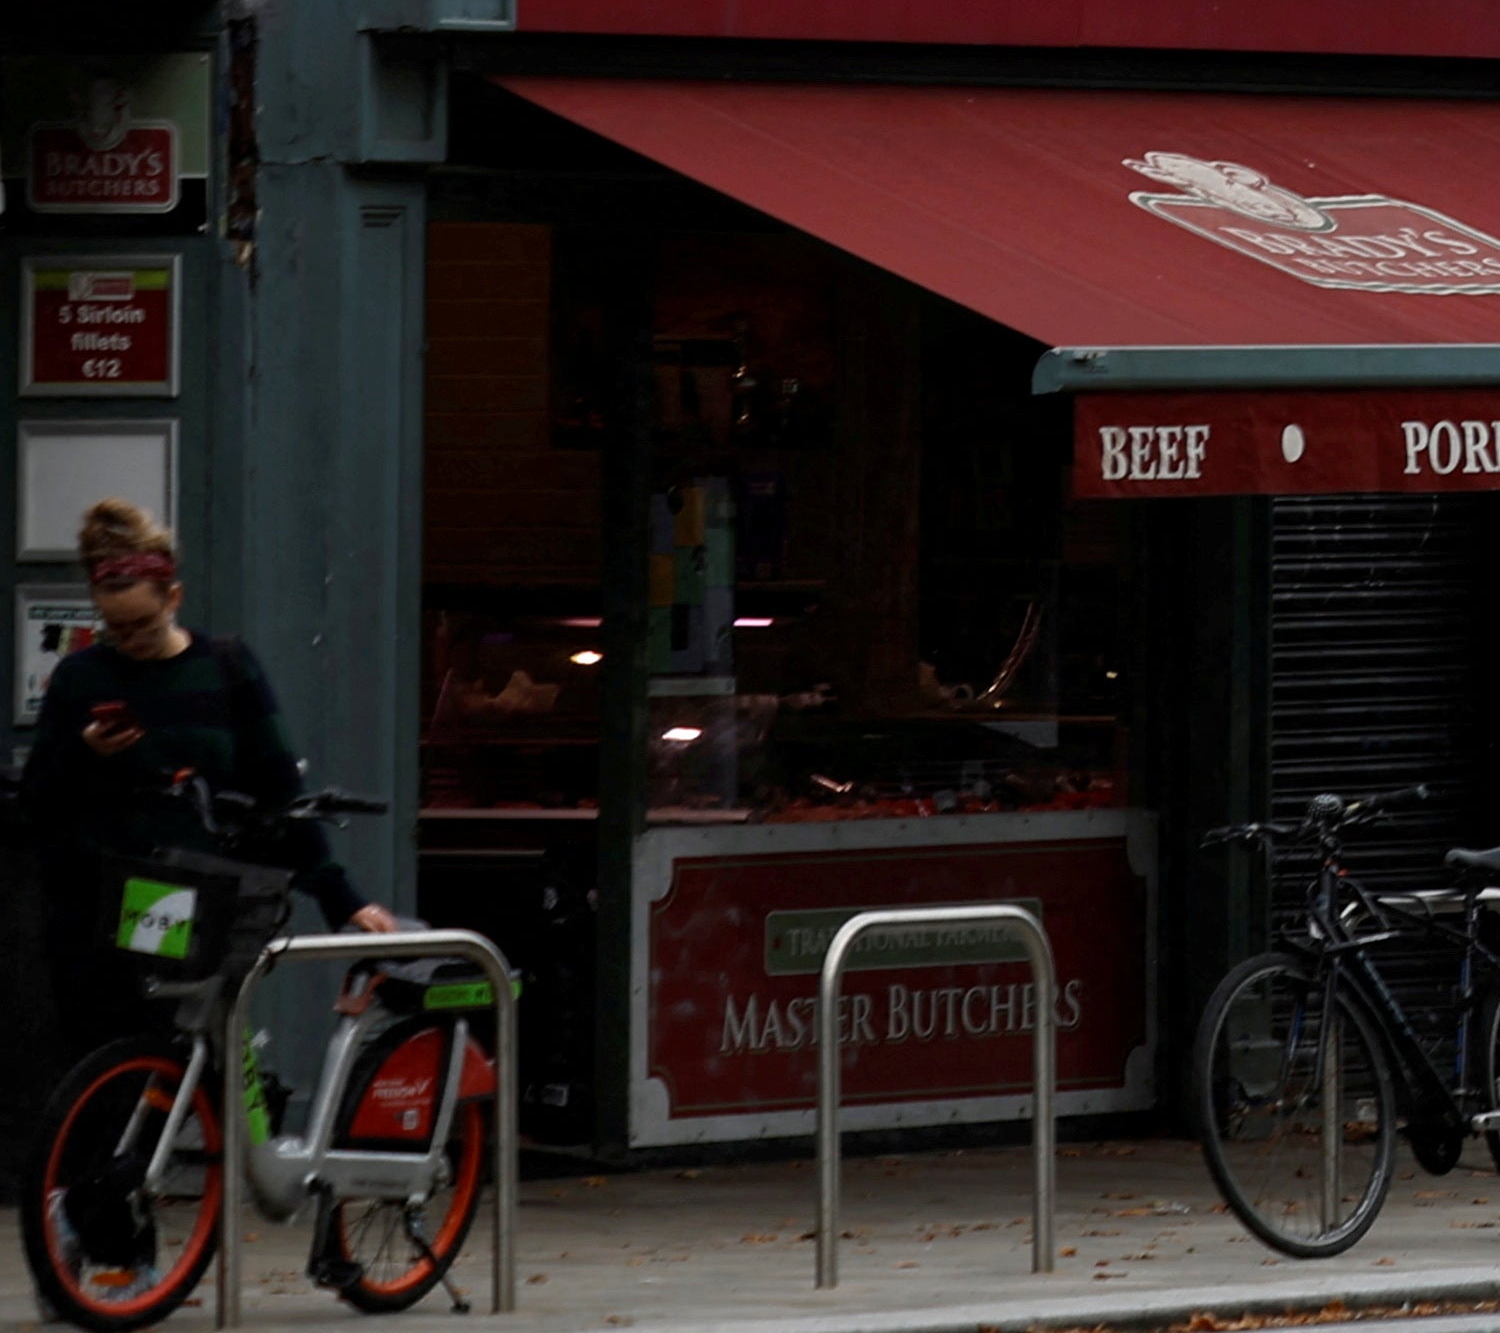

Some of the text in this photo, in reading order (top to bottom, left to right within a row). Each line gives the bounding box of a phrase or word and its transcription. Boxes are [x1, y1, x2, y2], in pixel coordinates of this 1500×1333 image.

[44, 147, 165, 178] BRADY'S
[47, 179, 161, 198] BUTCHERS
[1218, 225, 1479, 260] BRADY'S
[57, 303, 147, 326] 5 Sirloin
[69, 331, 133, 352] fillets
[81, 357, 123, 378] €12
[1098, 424, 1211, 482] BEEF
